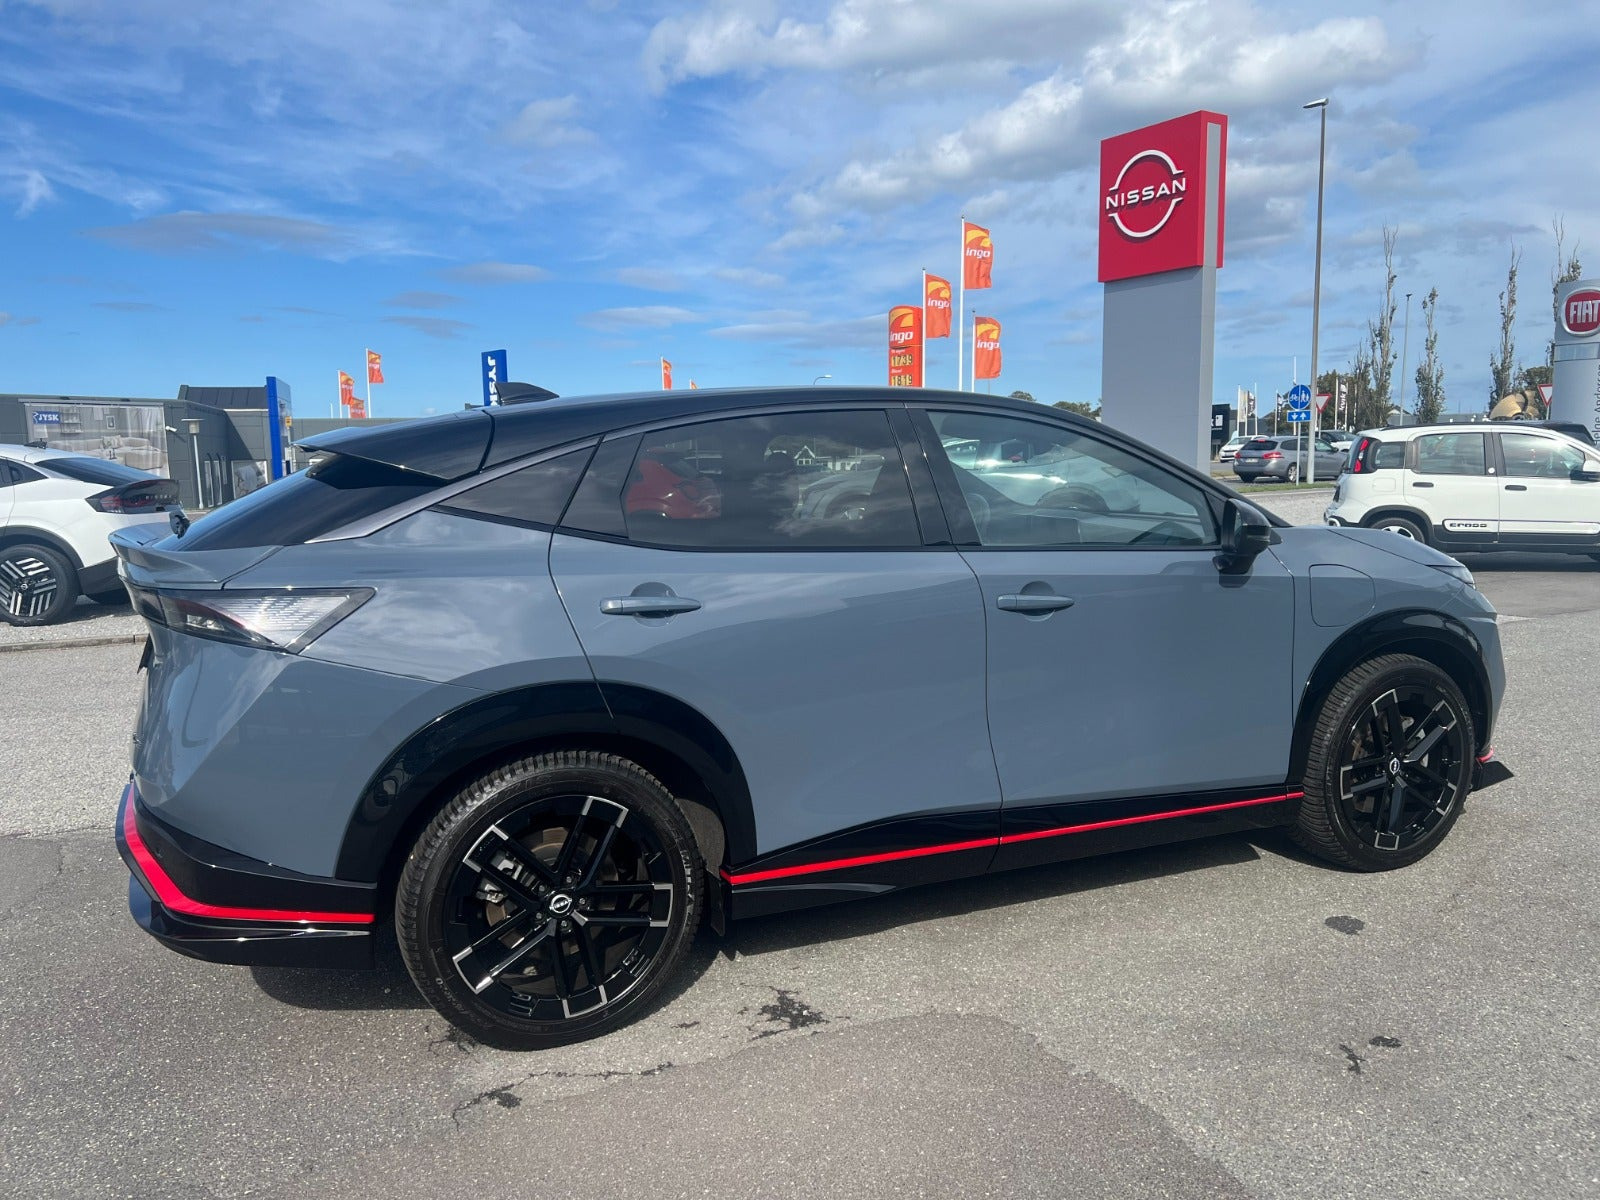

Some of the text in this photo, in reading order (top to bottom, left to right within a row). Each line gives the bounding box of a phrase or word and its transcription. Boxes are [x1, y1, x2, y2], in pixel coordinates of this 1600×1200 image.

[1105, 177, 1186, 210] NISSAN
[966, 247, 991, 259] ingo
[927, 297, 950, 309] ingo
[1570, 299, 1600, 324] FIAT
[889, 331, 914, 344] ingo
[976, 339, 1000, 351] ingo
[487, 355, 498, 406] JYSK
[38, 413, 60, 421] JYSK
